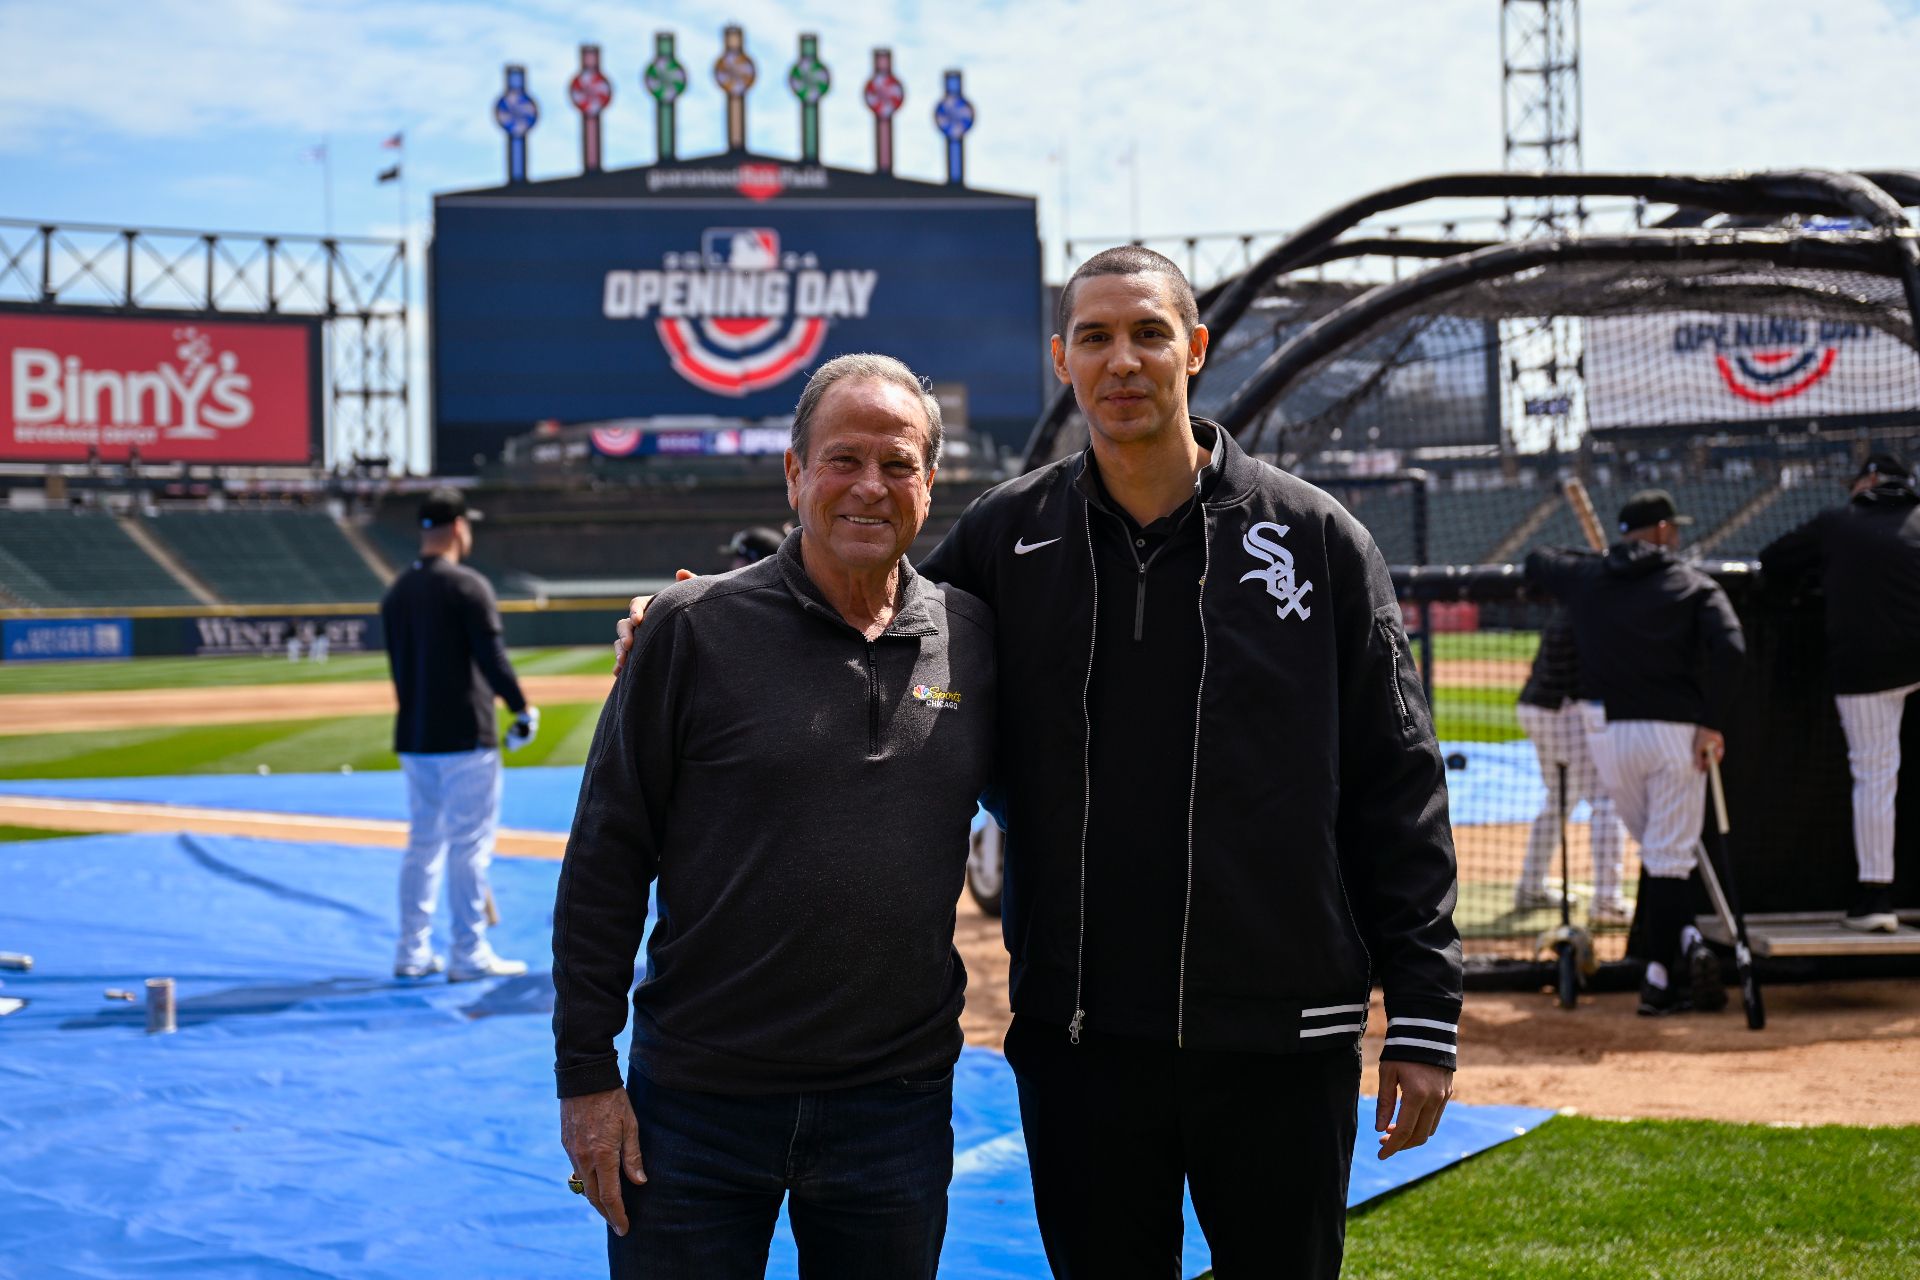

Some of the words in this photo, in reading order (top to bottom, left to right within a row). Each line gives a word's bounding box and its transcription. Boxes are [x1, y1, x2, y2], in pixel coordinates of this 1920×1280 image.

[603, 270, 788, 318] OPENING
[796, 270, 877, 318] DAY
[926, 699, 958, 710] CHICAGO
